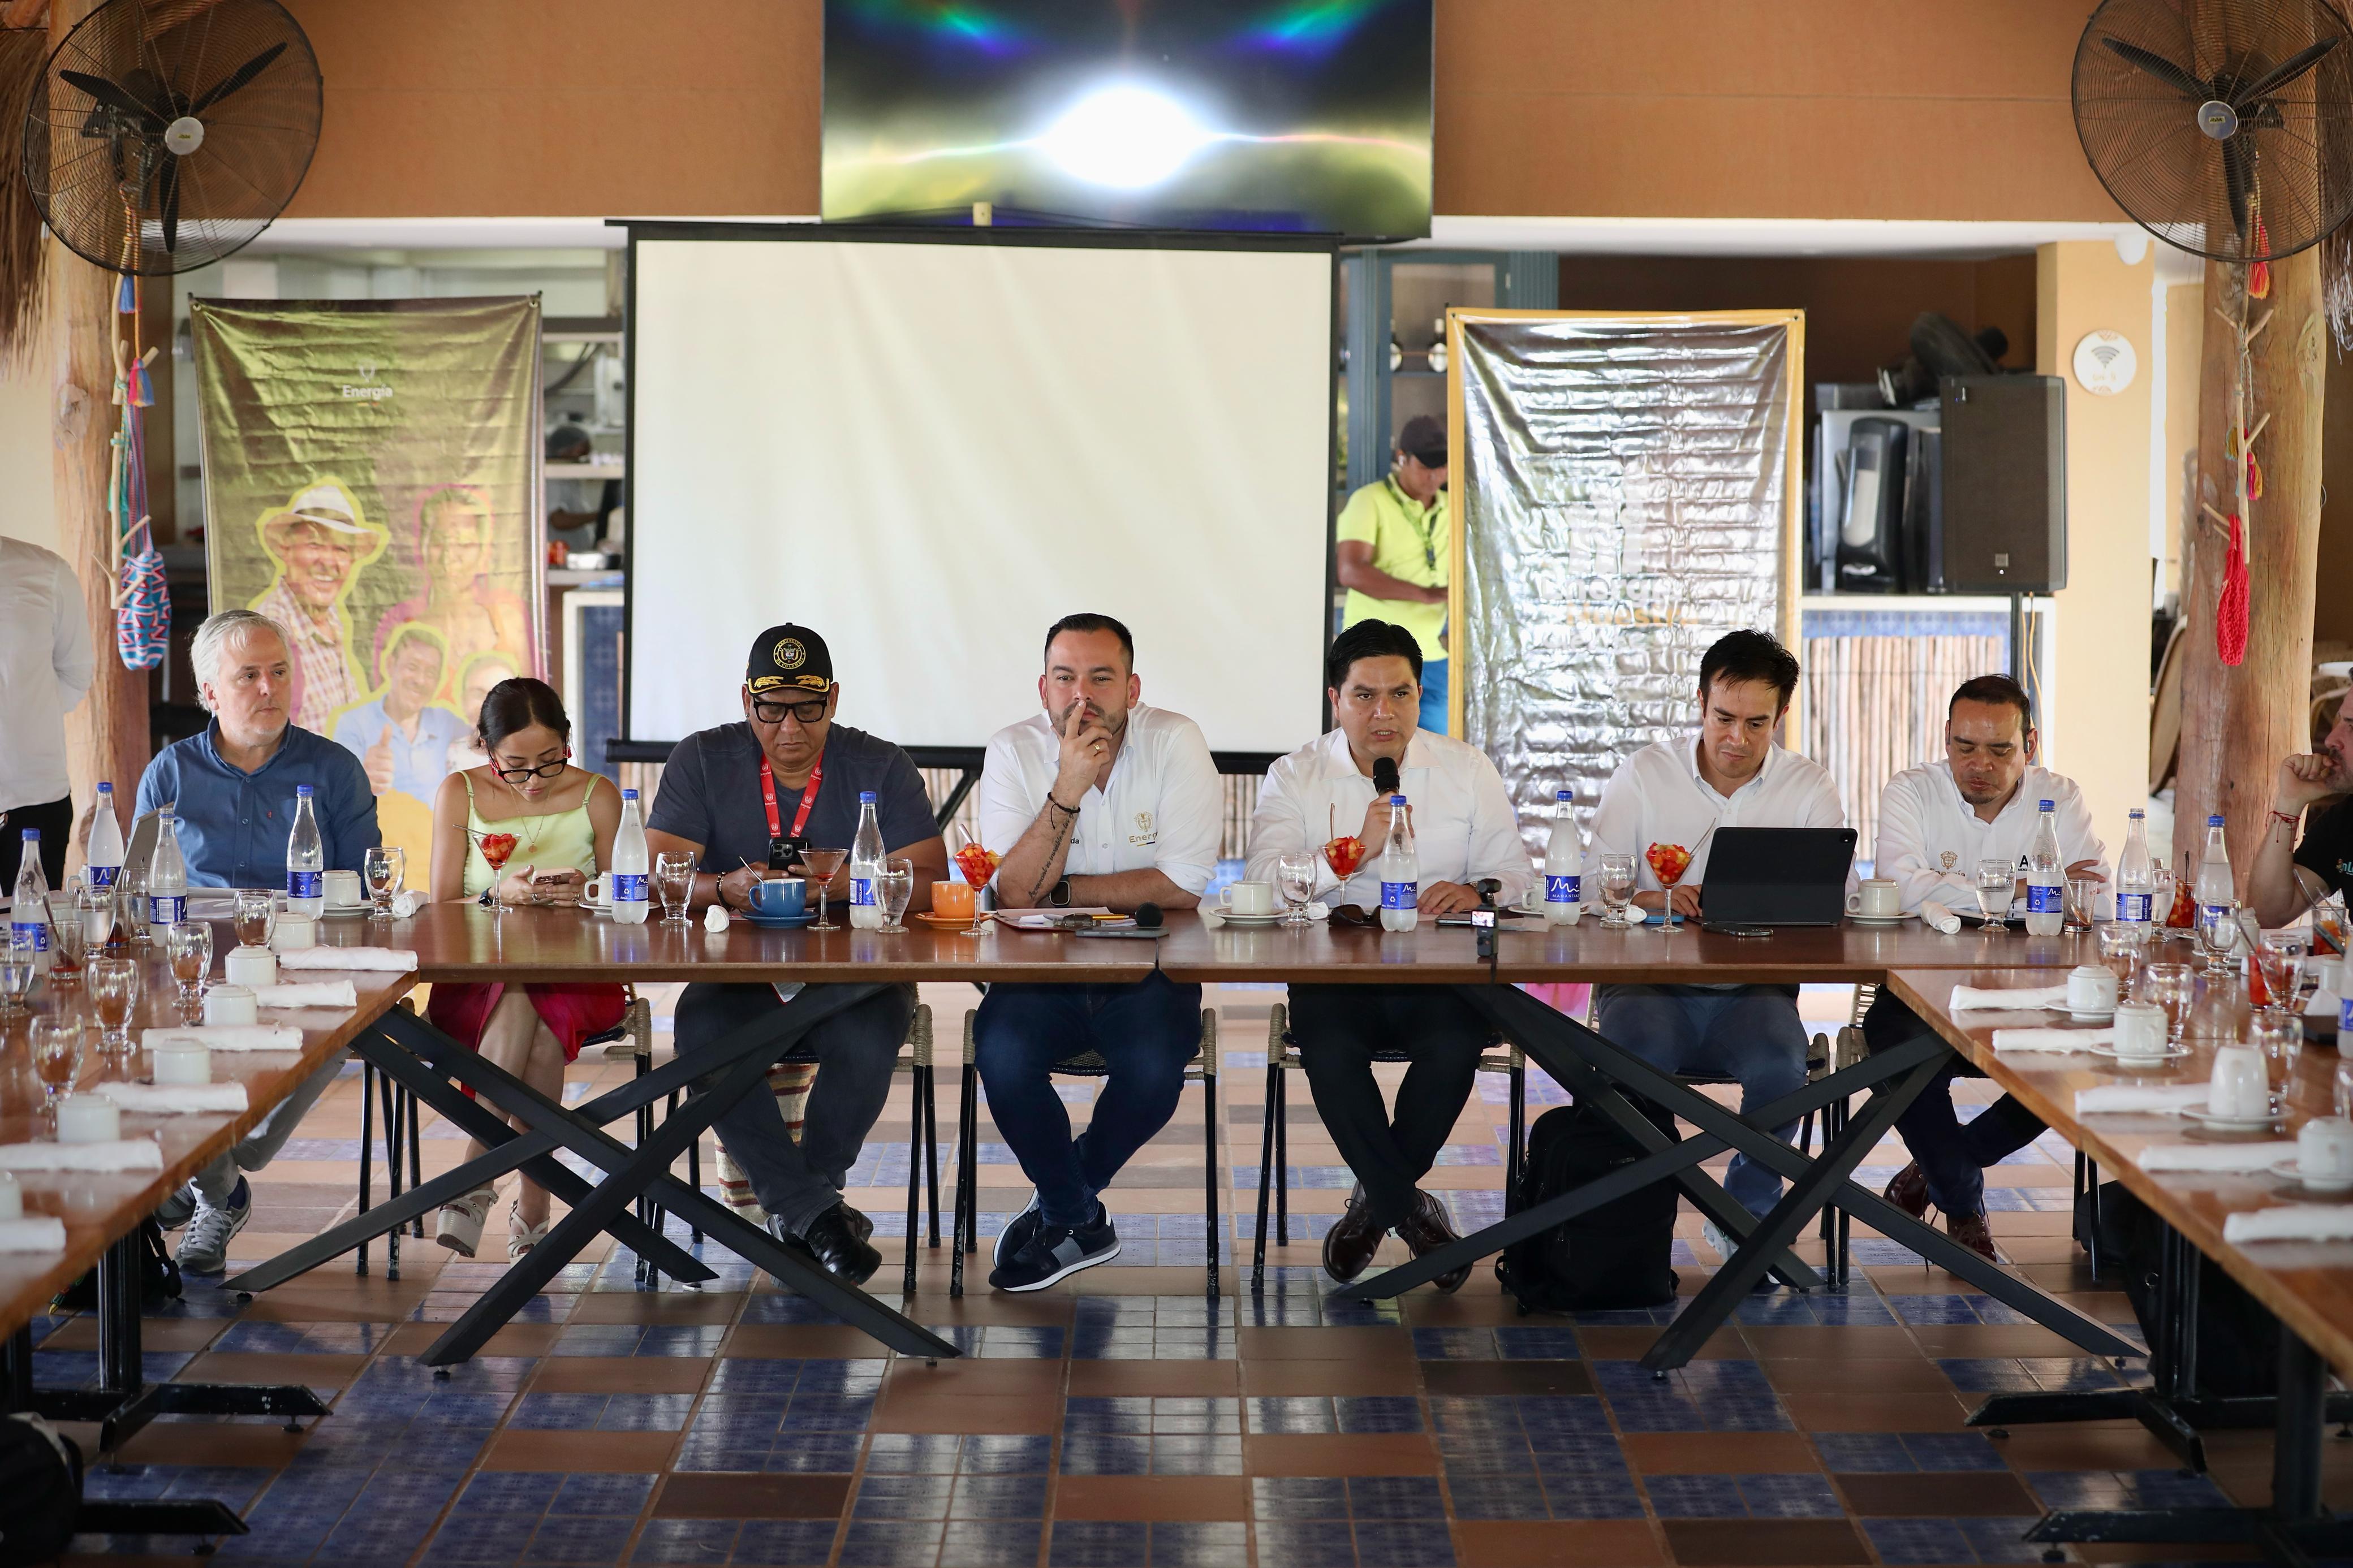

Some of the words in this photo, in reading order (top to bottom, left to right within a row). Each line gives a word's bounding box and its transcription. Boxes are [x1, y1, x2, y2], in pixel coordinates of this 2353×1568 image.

[342, 383, 394, 401] Energía
[1128, 831, 1158, 843] Energ
[1402, 884, 1416, 892] Mi
[1551, 877, 1580, 893] Mi
[2047, 888, 2062, 896] Mi
